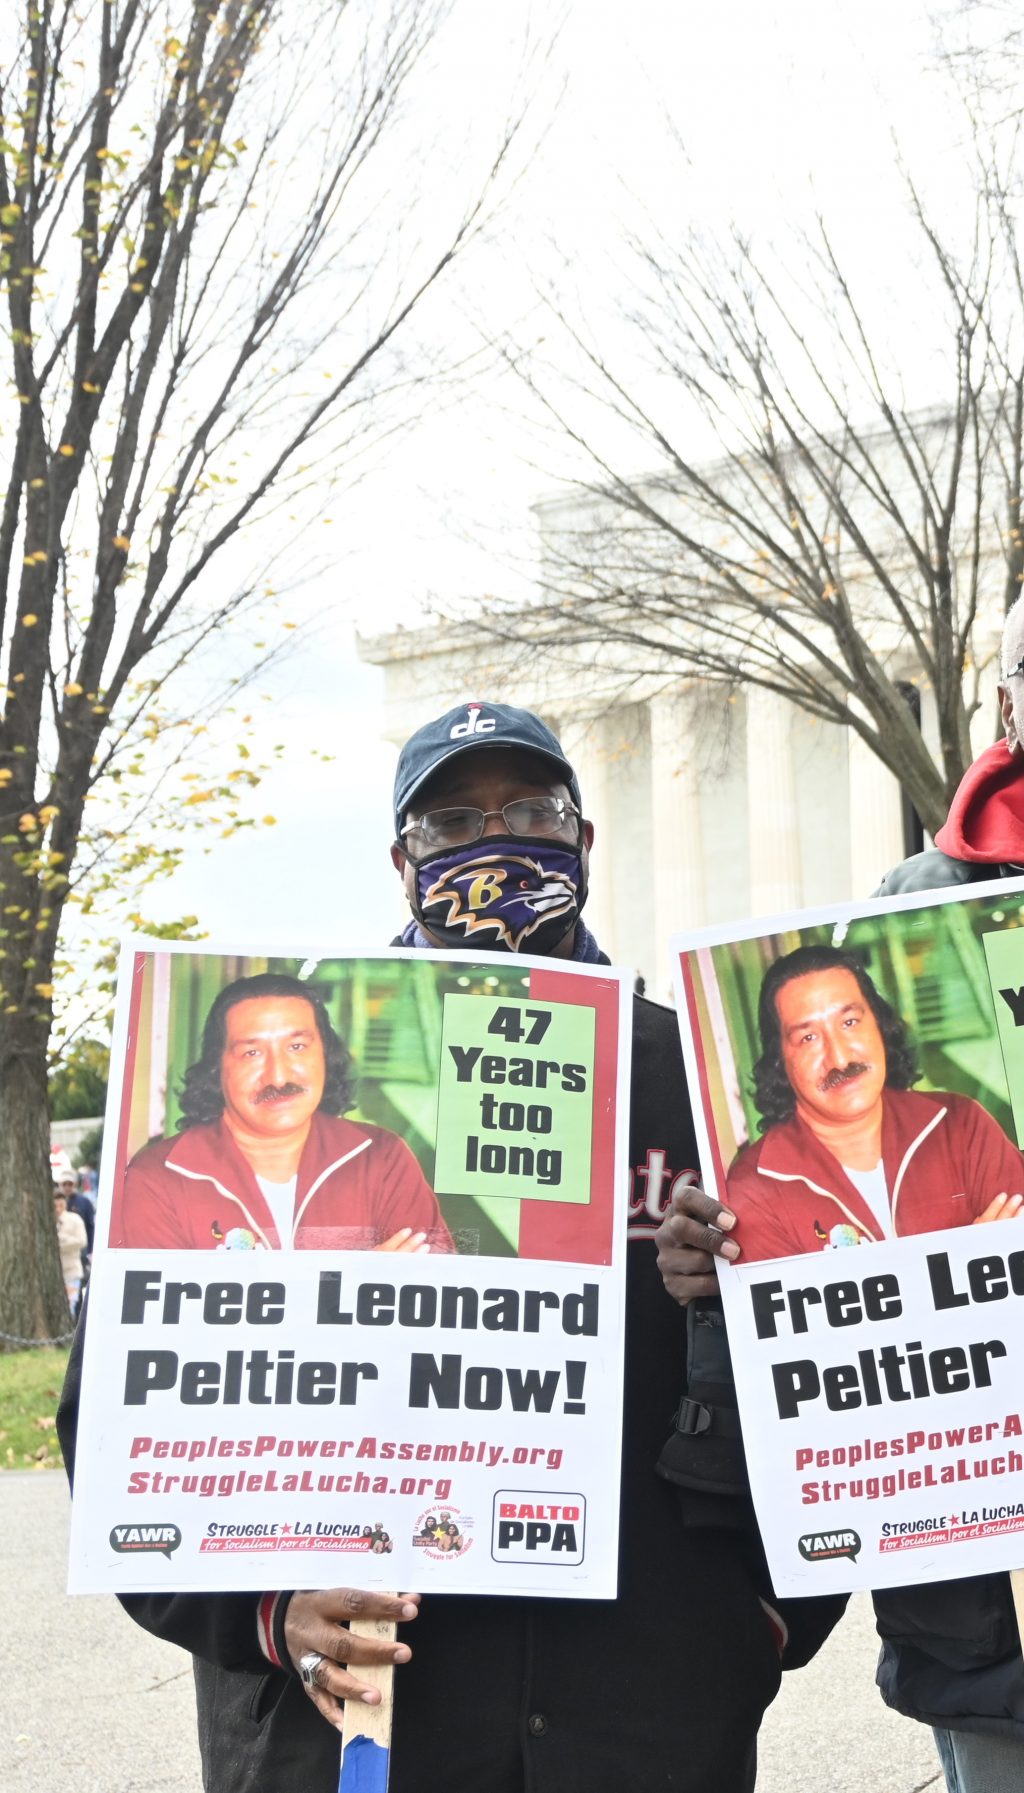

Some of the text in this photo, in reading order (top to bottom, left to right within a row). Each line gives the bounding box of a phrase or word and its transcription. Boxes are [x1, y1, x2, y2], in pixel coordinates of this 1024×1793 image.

[488, 1007, 551, 1044] 47
[449, 1046, 586, 1092] Years
[480, 1094, 552, 1133] too
[466, 1136, 561, 1185] long
[122, 1271, 598, 1336] Free Leonard
[751, 1275, 902, 1339] Free
[125, 1351, 586, 1414] Peltier Now!
[772, 1340, 1006, 1419] Peltier
[132, 1437, 562, 1468] PeoplesPowerAssembly.org
[129, 1472, 451, 1499] StruggleLaLucha.org
[500, 1504, 580, 1521] BALTO
[881, 1503, 1024, 1537] STRUGGLE LA LUCHA
[115, 1528, 176, 1542] YAWR
[207, 1521, 360, 1537] STRUGGLE LA LUCHA
[280, 1537, 369, 1551] por el Socialismo
[499, 1521, 576, 1551] PPA
[801, 1533, 856, 1552] YAWR
[883, 1532, 947, 1550] for Socialism
[952, 1530, 969, 1544] por
[969, 1526, 980, 1537] el
[204, 1538, 274, 1551] for Socialism
